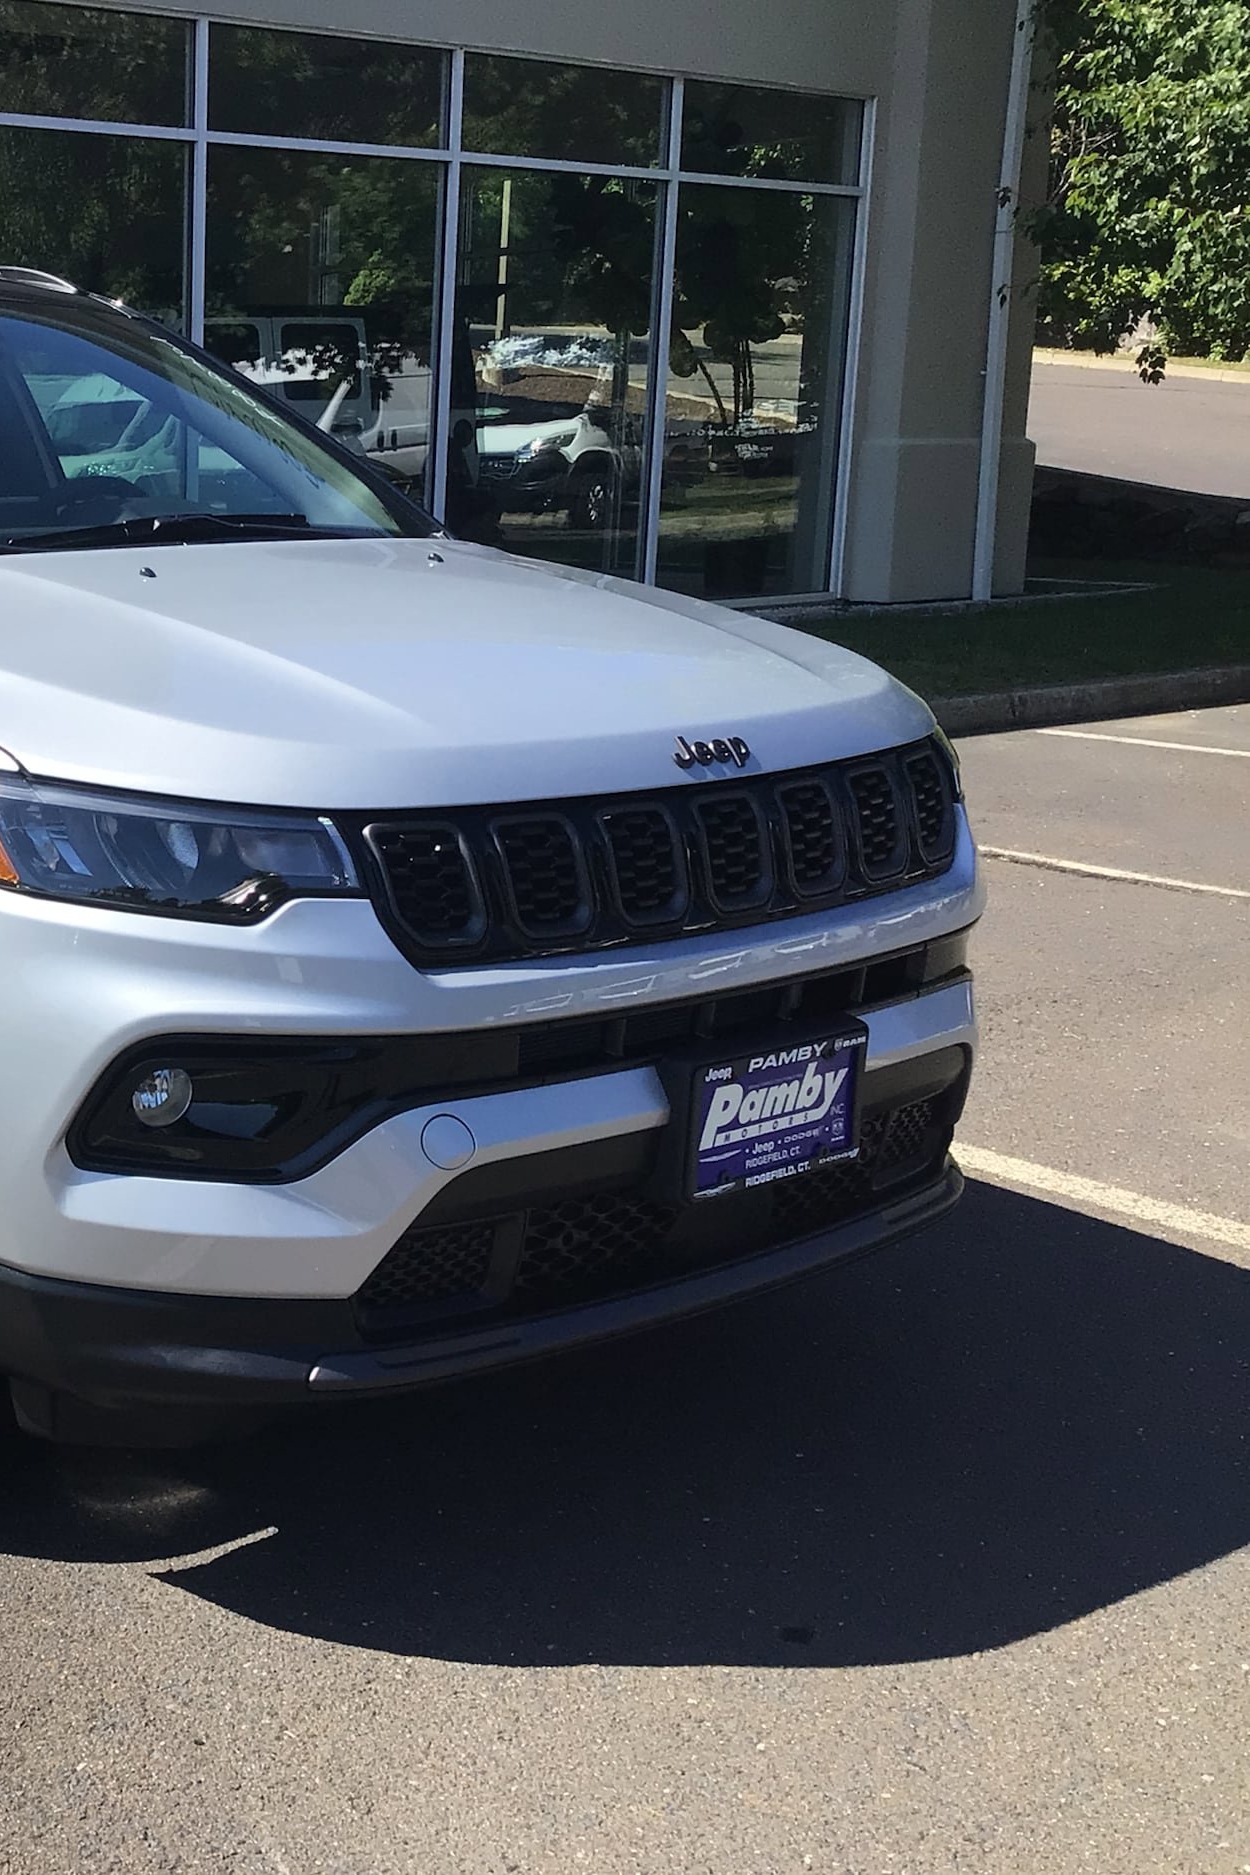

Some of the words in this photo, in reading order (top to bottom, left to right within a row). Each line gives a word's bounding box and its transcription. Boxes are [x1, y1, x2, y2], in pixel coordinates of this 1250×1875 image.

[671, 735, 751, 769] Jeep
[748, 1041, 827, 1072] PAMBY
[705, 1067, 732, 1082] Jeep
[699, 1061, 848, 1151] Pamby
[724, 1112, 809, 1142] MOTORS
[752, 1142, 775, 1155] Jeep
[745, 1165, 796, 1187] RIDGEFIELD,
[797, 1161, 810, 1173] CT.
